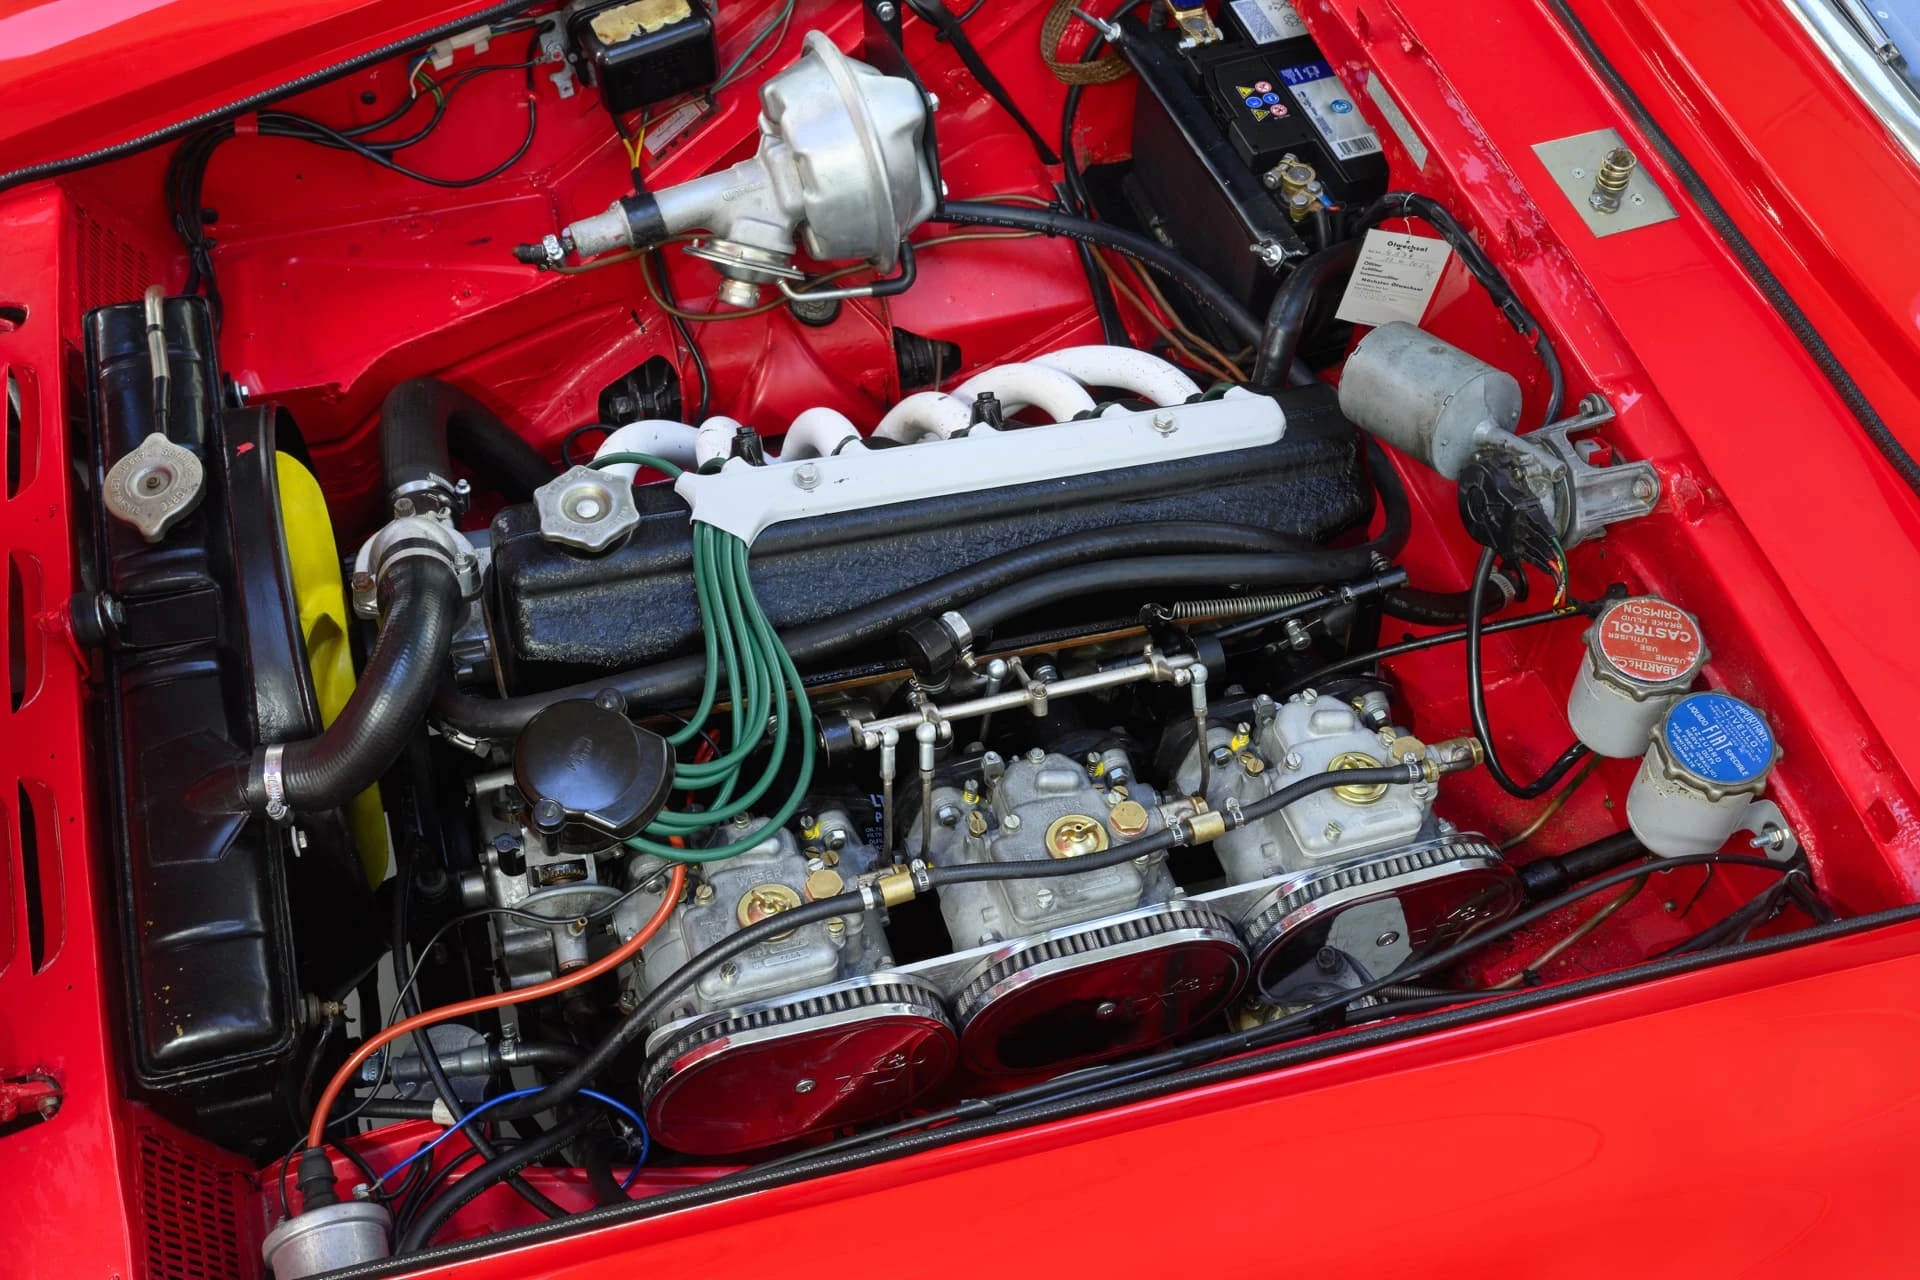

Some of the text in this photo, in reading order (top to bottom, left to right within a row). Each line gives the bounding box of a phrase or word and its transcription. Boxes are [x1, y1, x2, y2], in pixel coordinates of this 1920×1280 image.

[1624, 604, 1682, 620] CRIMSON
[1611, 620, 1692, 642] CASTROL
[1621, 615, 1682, 629] BRAKE FLUID
[1608, 632, 1648, 644] UTILISER
[1640, 644, 1658, 652] USE
[1736, 705, 1768, 742] IMPORTANTE
[1686, 729, 1716, 765] HEAVY DUTY
[1687, 702, 1708, 726] LIQUIDO
[1702, 724, 1733, 751] FIAT
[1724, 748, 1749, 776] SPECIALE
[1691, 726, 1722, 763] AZZURRO
[1694, 760, 1708, 776] LATTE
